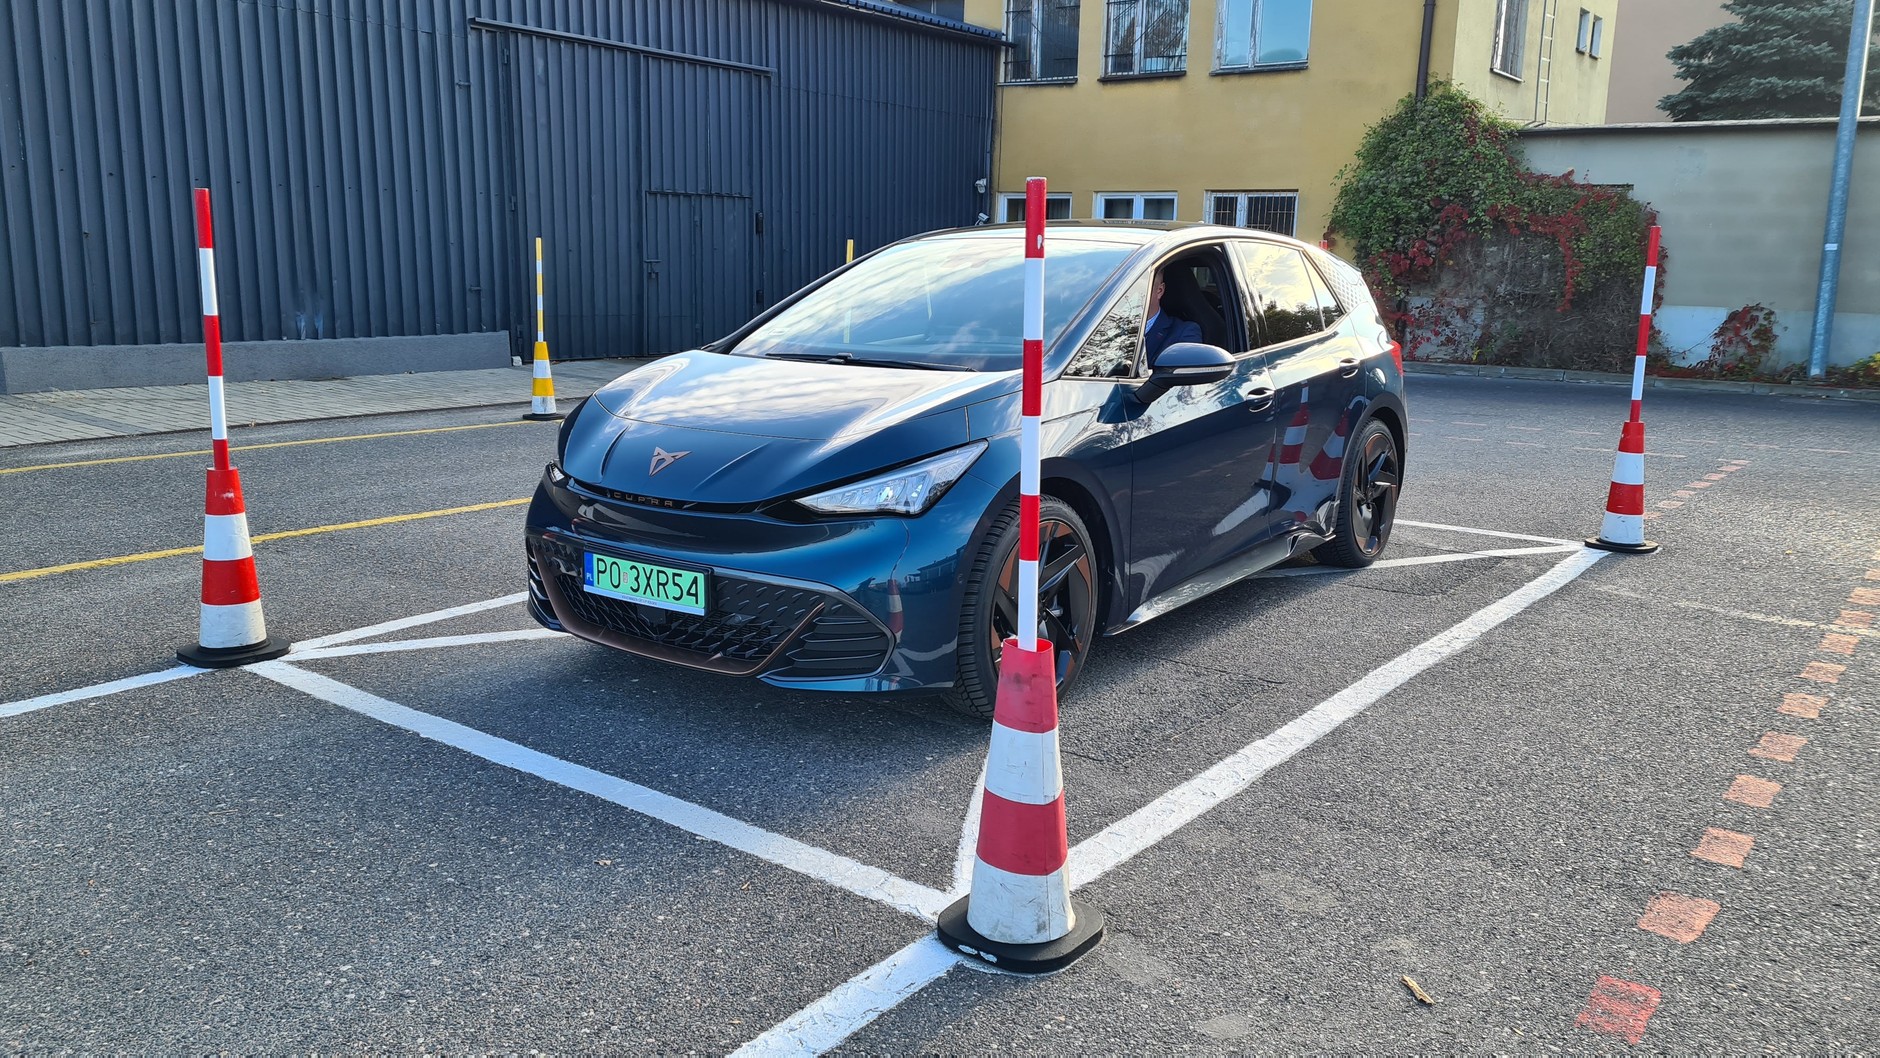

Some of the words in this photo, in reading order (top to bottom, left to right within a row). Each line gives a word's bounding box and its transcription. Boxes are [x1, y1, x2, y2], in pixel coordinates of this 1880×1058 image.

[613, 491, 673, 507] CUPRA
[586, 572, 593, 581] PL
[596, 557, 621, 589] PO
[629, 564, 699, 605] 3XR54
